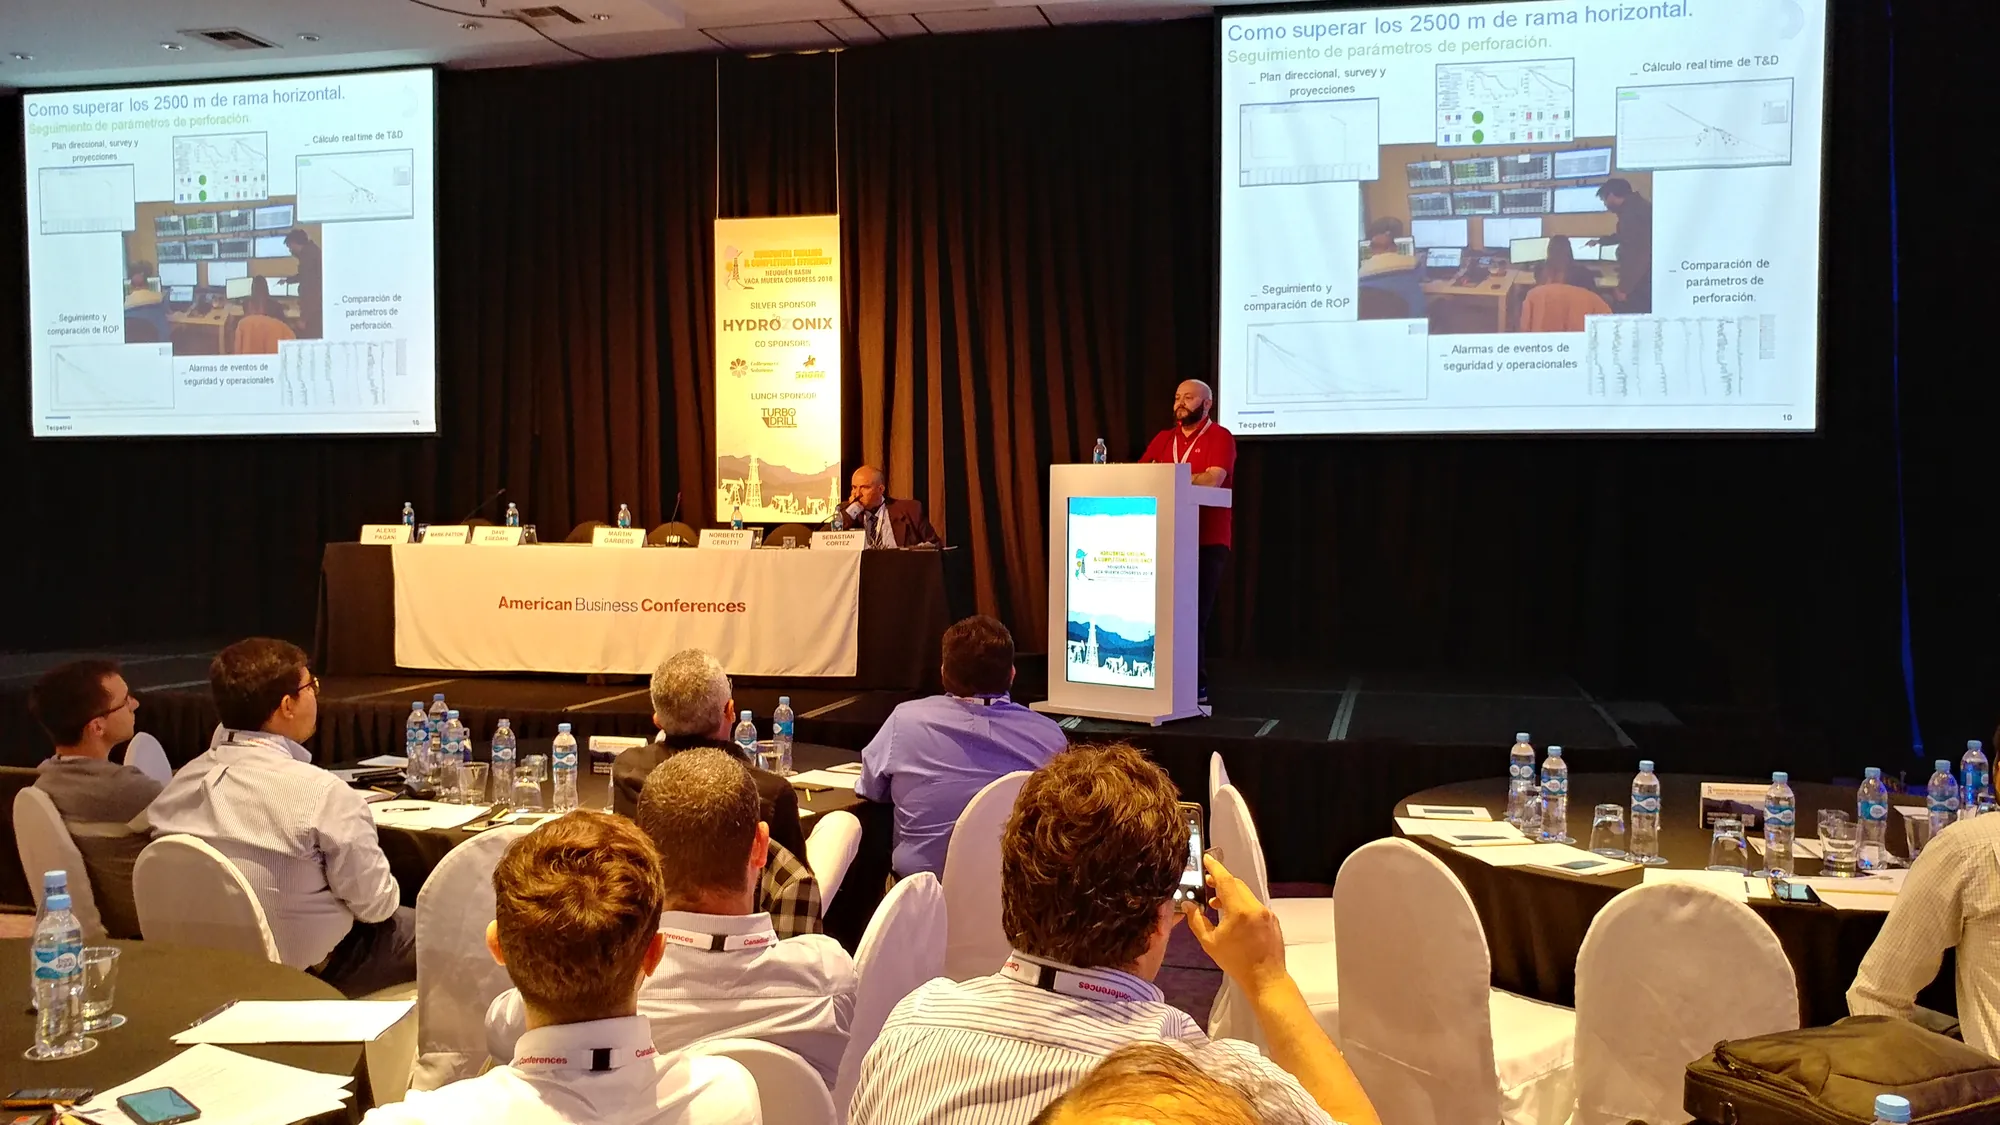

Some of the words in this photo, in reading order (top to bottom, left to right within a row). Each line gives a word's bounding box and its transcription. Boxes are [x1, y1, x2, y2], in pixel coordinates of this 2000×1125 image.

[1228, 24, 1286, 41] Como
[1293, 20, 1367, 41] superar
[1375, 17, 1402, 34] los
[1410, 13, 1460, 32] 2500
[1468, 15, 1485, 30] m
[1493, 10, 1517, 28] de
[1525, 9, 1578, 26] rama
[1585, 0, 1693, 23] horizontal.
[1228, 47, 1320, 65] Seguimiento
[1324, 45, 1342, 58] de
[1348, 41, 1432, 60] parámetros
[1438, 40, 1456, 52] de
[1462, 35, 1551, 54] perforación.
[1642, 62, 1681, 72] Cálculo
[1686, 60, 1707, 70] real
[1710, 59, 1733, 68] time
[1737, 57, 1750, 67] de
[1754, 55, 1779, 66] T&D
[1260, 72, 1281, 82] Plan
[1285, 69, 1340, 80] direccional,
[1344, 68, 1376, 78] survey
[1380, 68, 1386, 77] y
[1290, 84, 1355, 98] proyecciones
[28, 103, 68, 116] Como
[72, 100, 124, 117] superar
[130, 98, 148, 111] los
[154, 94, 188, 110] 2500
[194, 96, 206, 108] m
[211, 92, 227, 106] de
[233, 91, 268, 106] rama
[273, 85, 345, 104] horizontal.
[28, 122, 92, 136] Seguimiento
[95, 120, 108, 131] de
[111, 117, 169, 132] parámetros
[174, 116, 186, 127] de
[312, 133, 339, 144] Cálculo
[342, 133, 356, 142] real
[357, 132, 373, 141] time
[376, 130, 384, 140] de
[386, 130, 404, 139] T&D
[52, 142, 66, 150] Plan
[110, 138, 132, 148] survey
[134, 139, 139, 147] y
[72, 152, 117, 163] proyecciones
[1681, 258, 1752, 271] Comparación
[1756, 259, 1770, 268] de
[1686, 276, 1748, 289] parámetros
[1750, 275, 1764, 285] de
[1262, 284, 1322, 296] Seguimiento
[1326, 285, 1332, 294] y
[342, 293, 390, 304] Comparación
[392, 293, 402, 302] de
[1692, 292, 1756, 305] perforación.
[779, 301, 816, 309] SPONSOR
[1244, 300, 1306, 312] comparación
[1310, 299, 1323, 308] de
[1326, 298, 1350, 308] ROP
[58, 313, 100, 323] Seguimiento
[346, 308, 387, 318] parámetros
[389, 307, 398, 315] de
[47, 326, 90, 336] comparación
[92, 326, 100, 334] de
[103, 325, 119, 334] ROP
[1451, 345, 1493, 355] Alarmas
[1497, 344, 1510, 353] de
[1513, 344, 1553, 353] eventos
[1557, 343, 1569, 352] de
[189, 364, 217, 372] Alarmas
[230, 363, 257, 371] eventos
[260, 363, 268, 371] de
[1444, 360, 1493, 373] seguridad
[1497, 362, 1503, 372] y
[1506, 359, 1578, 371] operacionales
[184, 377, 217, 387] seguridad
[220, 378, 224, 386] y
[226, 376, 274, 386] operacionales
[780, 392, 816, 400] SPONSOR
[761, 408, 796, 416] TURBO
[770, 416, 796, 425] DRILL
[1238, 421, 1276, 430] Tecpetrol
[498, 596, 572, 611] American
[575, 597, 638, 612] Business
[641, 598, 746, 613] Conferences
[1078, 981, 1132, 1002] Conferences
